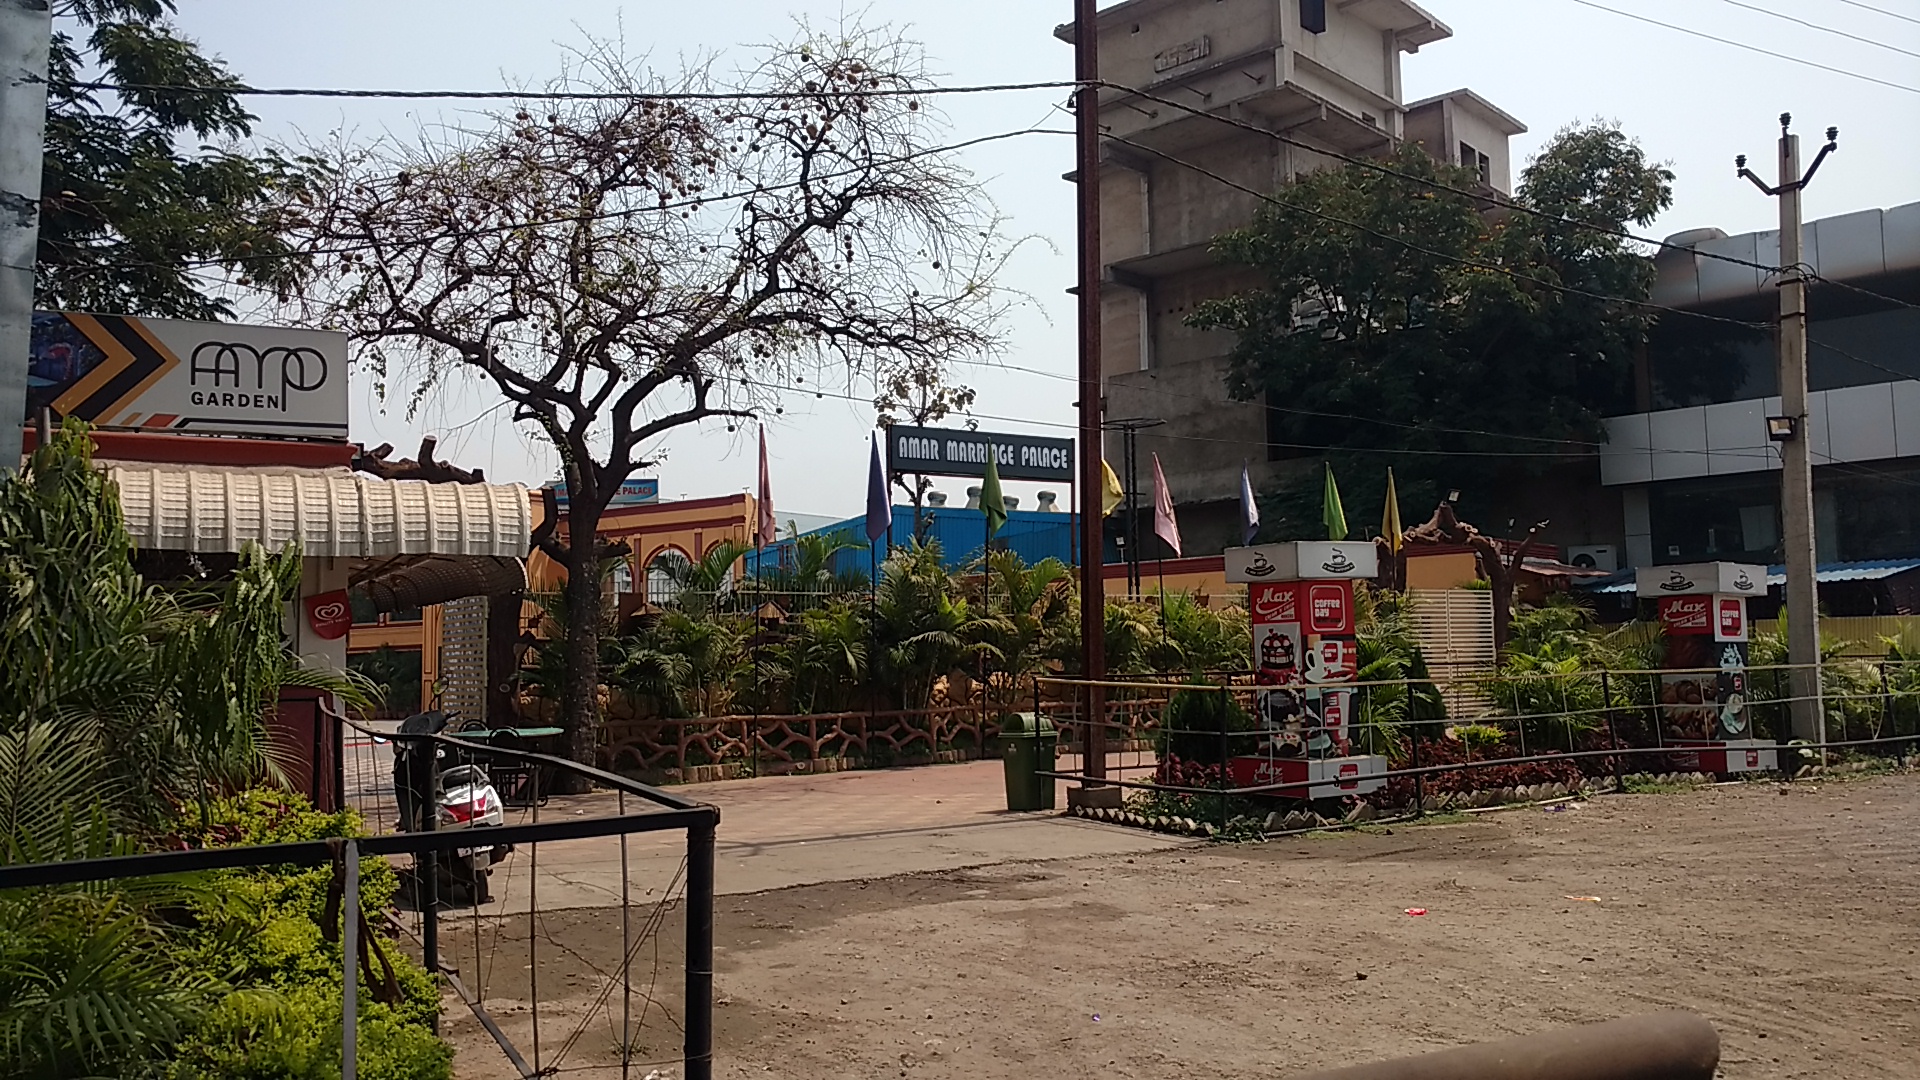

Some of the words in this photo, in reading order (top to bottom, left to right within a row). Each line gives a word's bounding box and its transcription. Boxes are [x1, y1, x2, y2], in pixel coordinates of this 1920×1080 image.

[190, 391, 280, 409] GARDEN
[899, 436, 940, 460] AMAR
[1021, 445, 1068, 469] PALACE
[622, 486, 653, 495] PALACE
